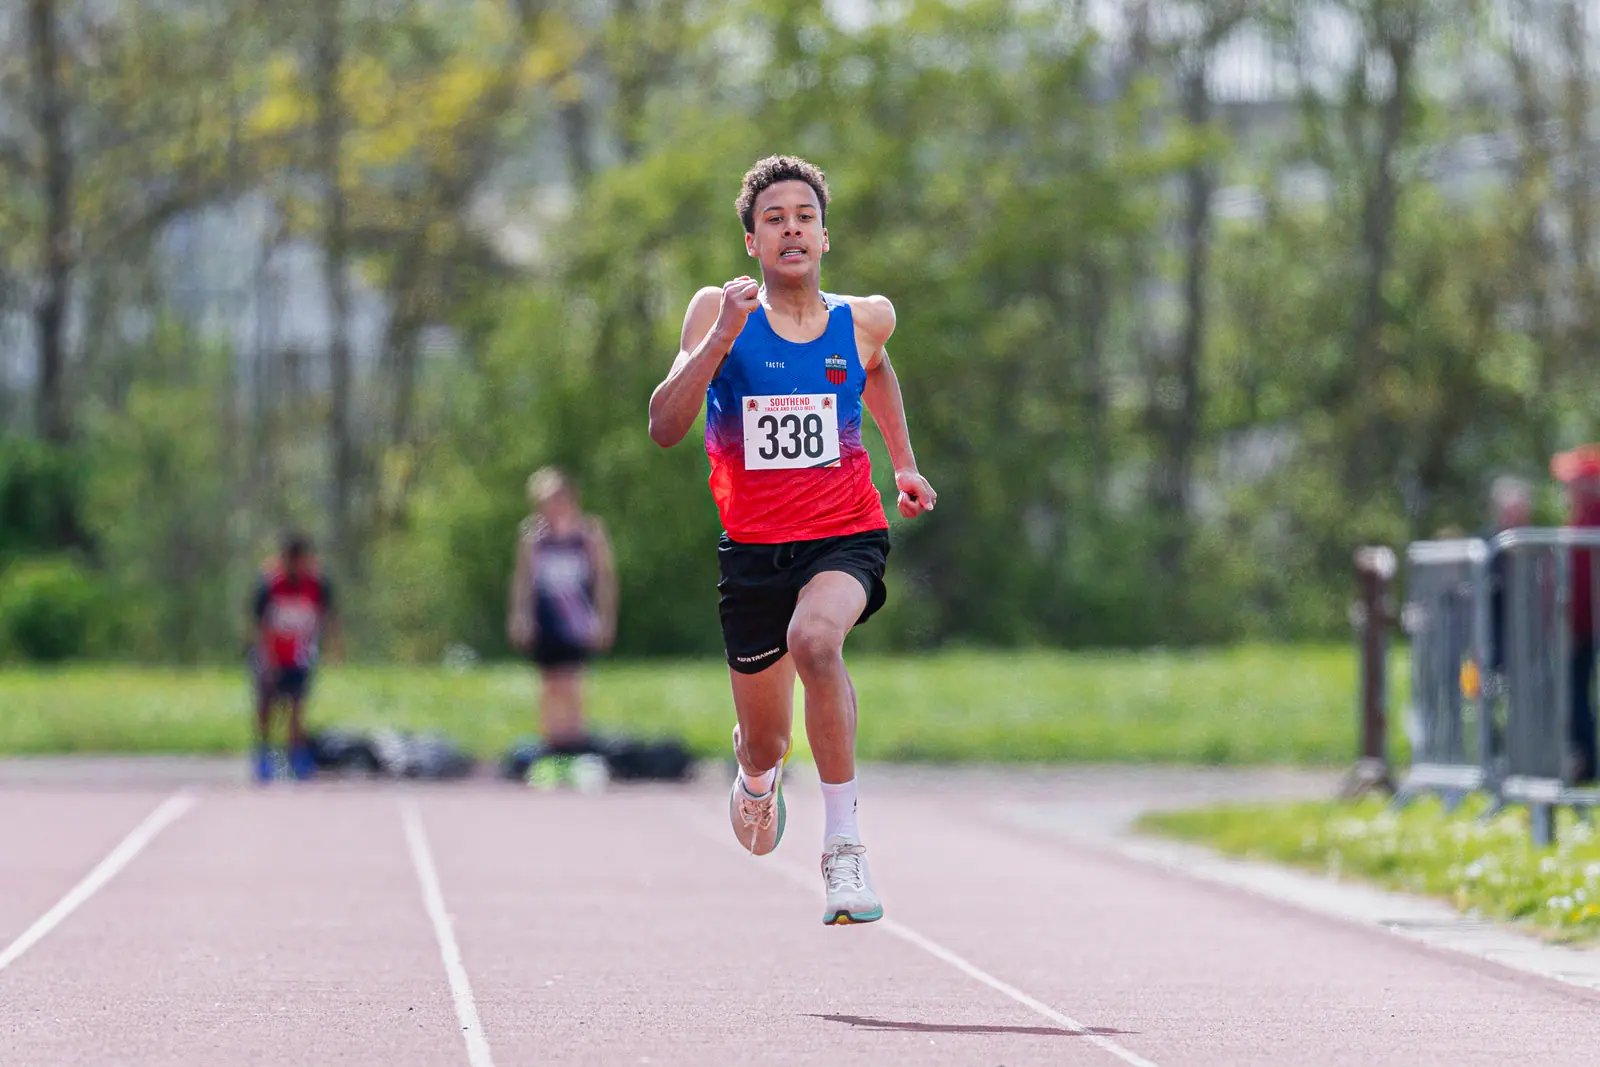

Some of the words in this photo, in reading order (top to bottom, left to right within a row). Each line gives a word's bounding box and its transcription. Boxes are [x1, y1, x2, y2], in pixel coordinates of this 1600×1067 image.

[765, 361, 785, 369] TACTIC
[769, 397, 810, 407] SOUTHEND
[757, 413, 824, 460] 338
